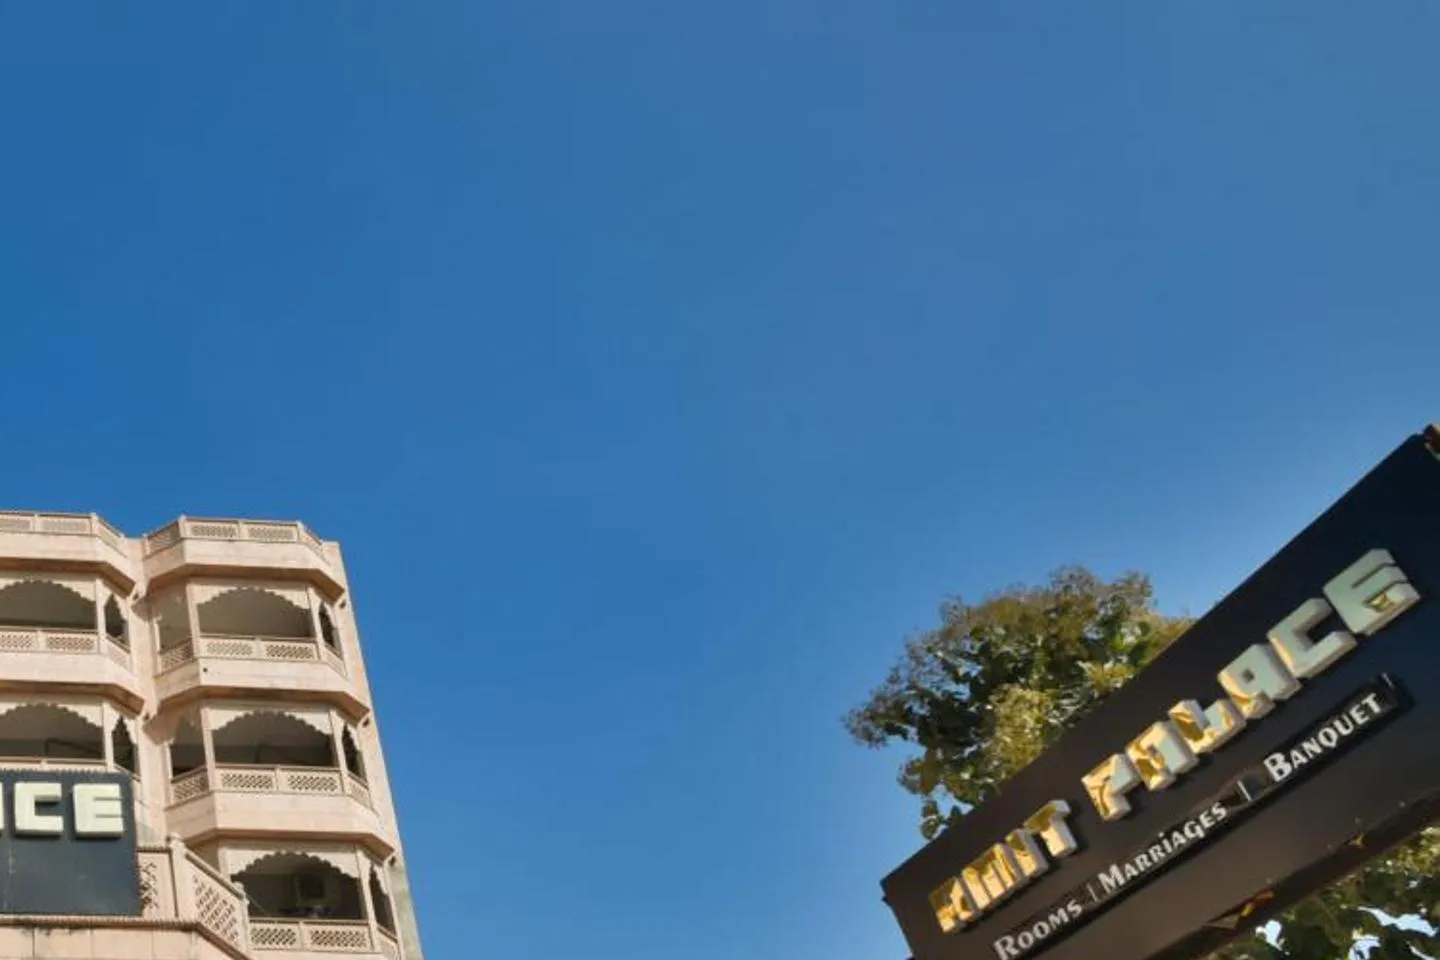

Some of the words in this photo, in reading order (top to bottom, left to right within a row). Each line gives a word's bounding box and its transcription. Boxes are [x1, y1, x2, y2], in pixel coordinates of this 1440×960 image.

[928, 798, 1079, 934] AMIT
[1080, 547, 1421, 822] PALACE
[1263, 692, 1384, 783] BANQUET
